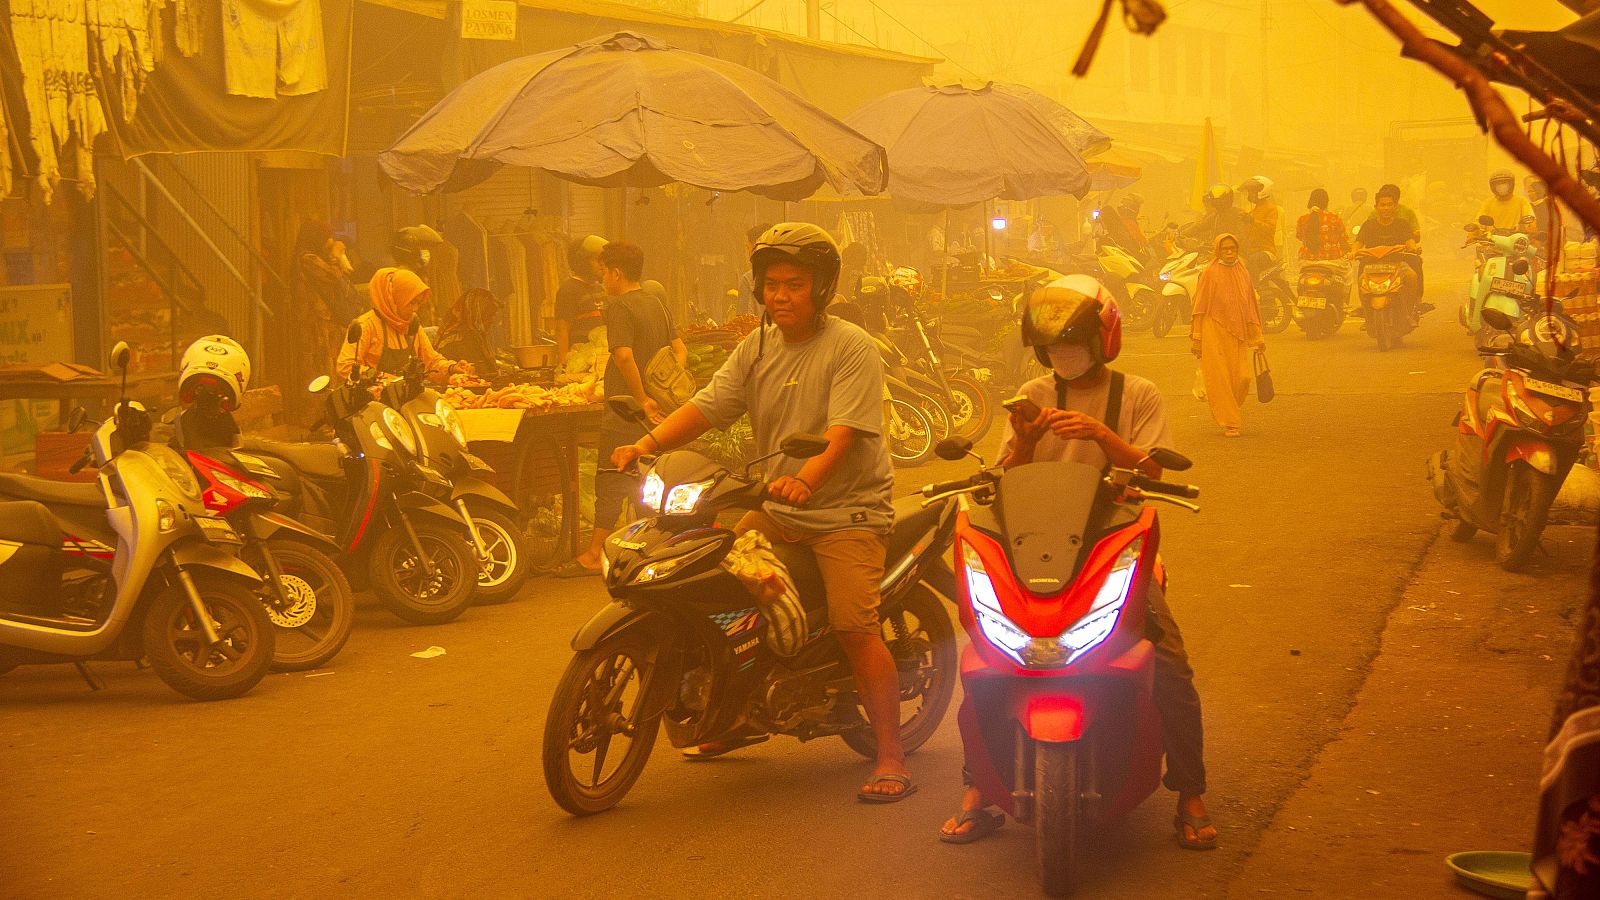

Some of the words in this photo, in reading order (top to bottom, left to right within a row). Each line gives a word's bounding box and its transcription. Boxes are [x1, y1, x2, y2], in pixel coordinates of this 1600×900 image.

[465, 9, 513, 21] LOSMEN
[465, 22, 513, 35] PAYANG
[733, 636, 760, 655] YAMAHA
